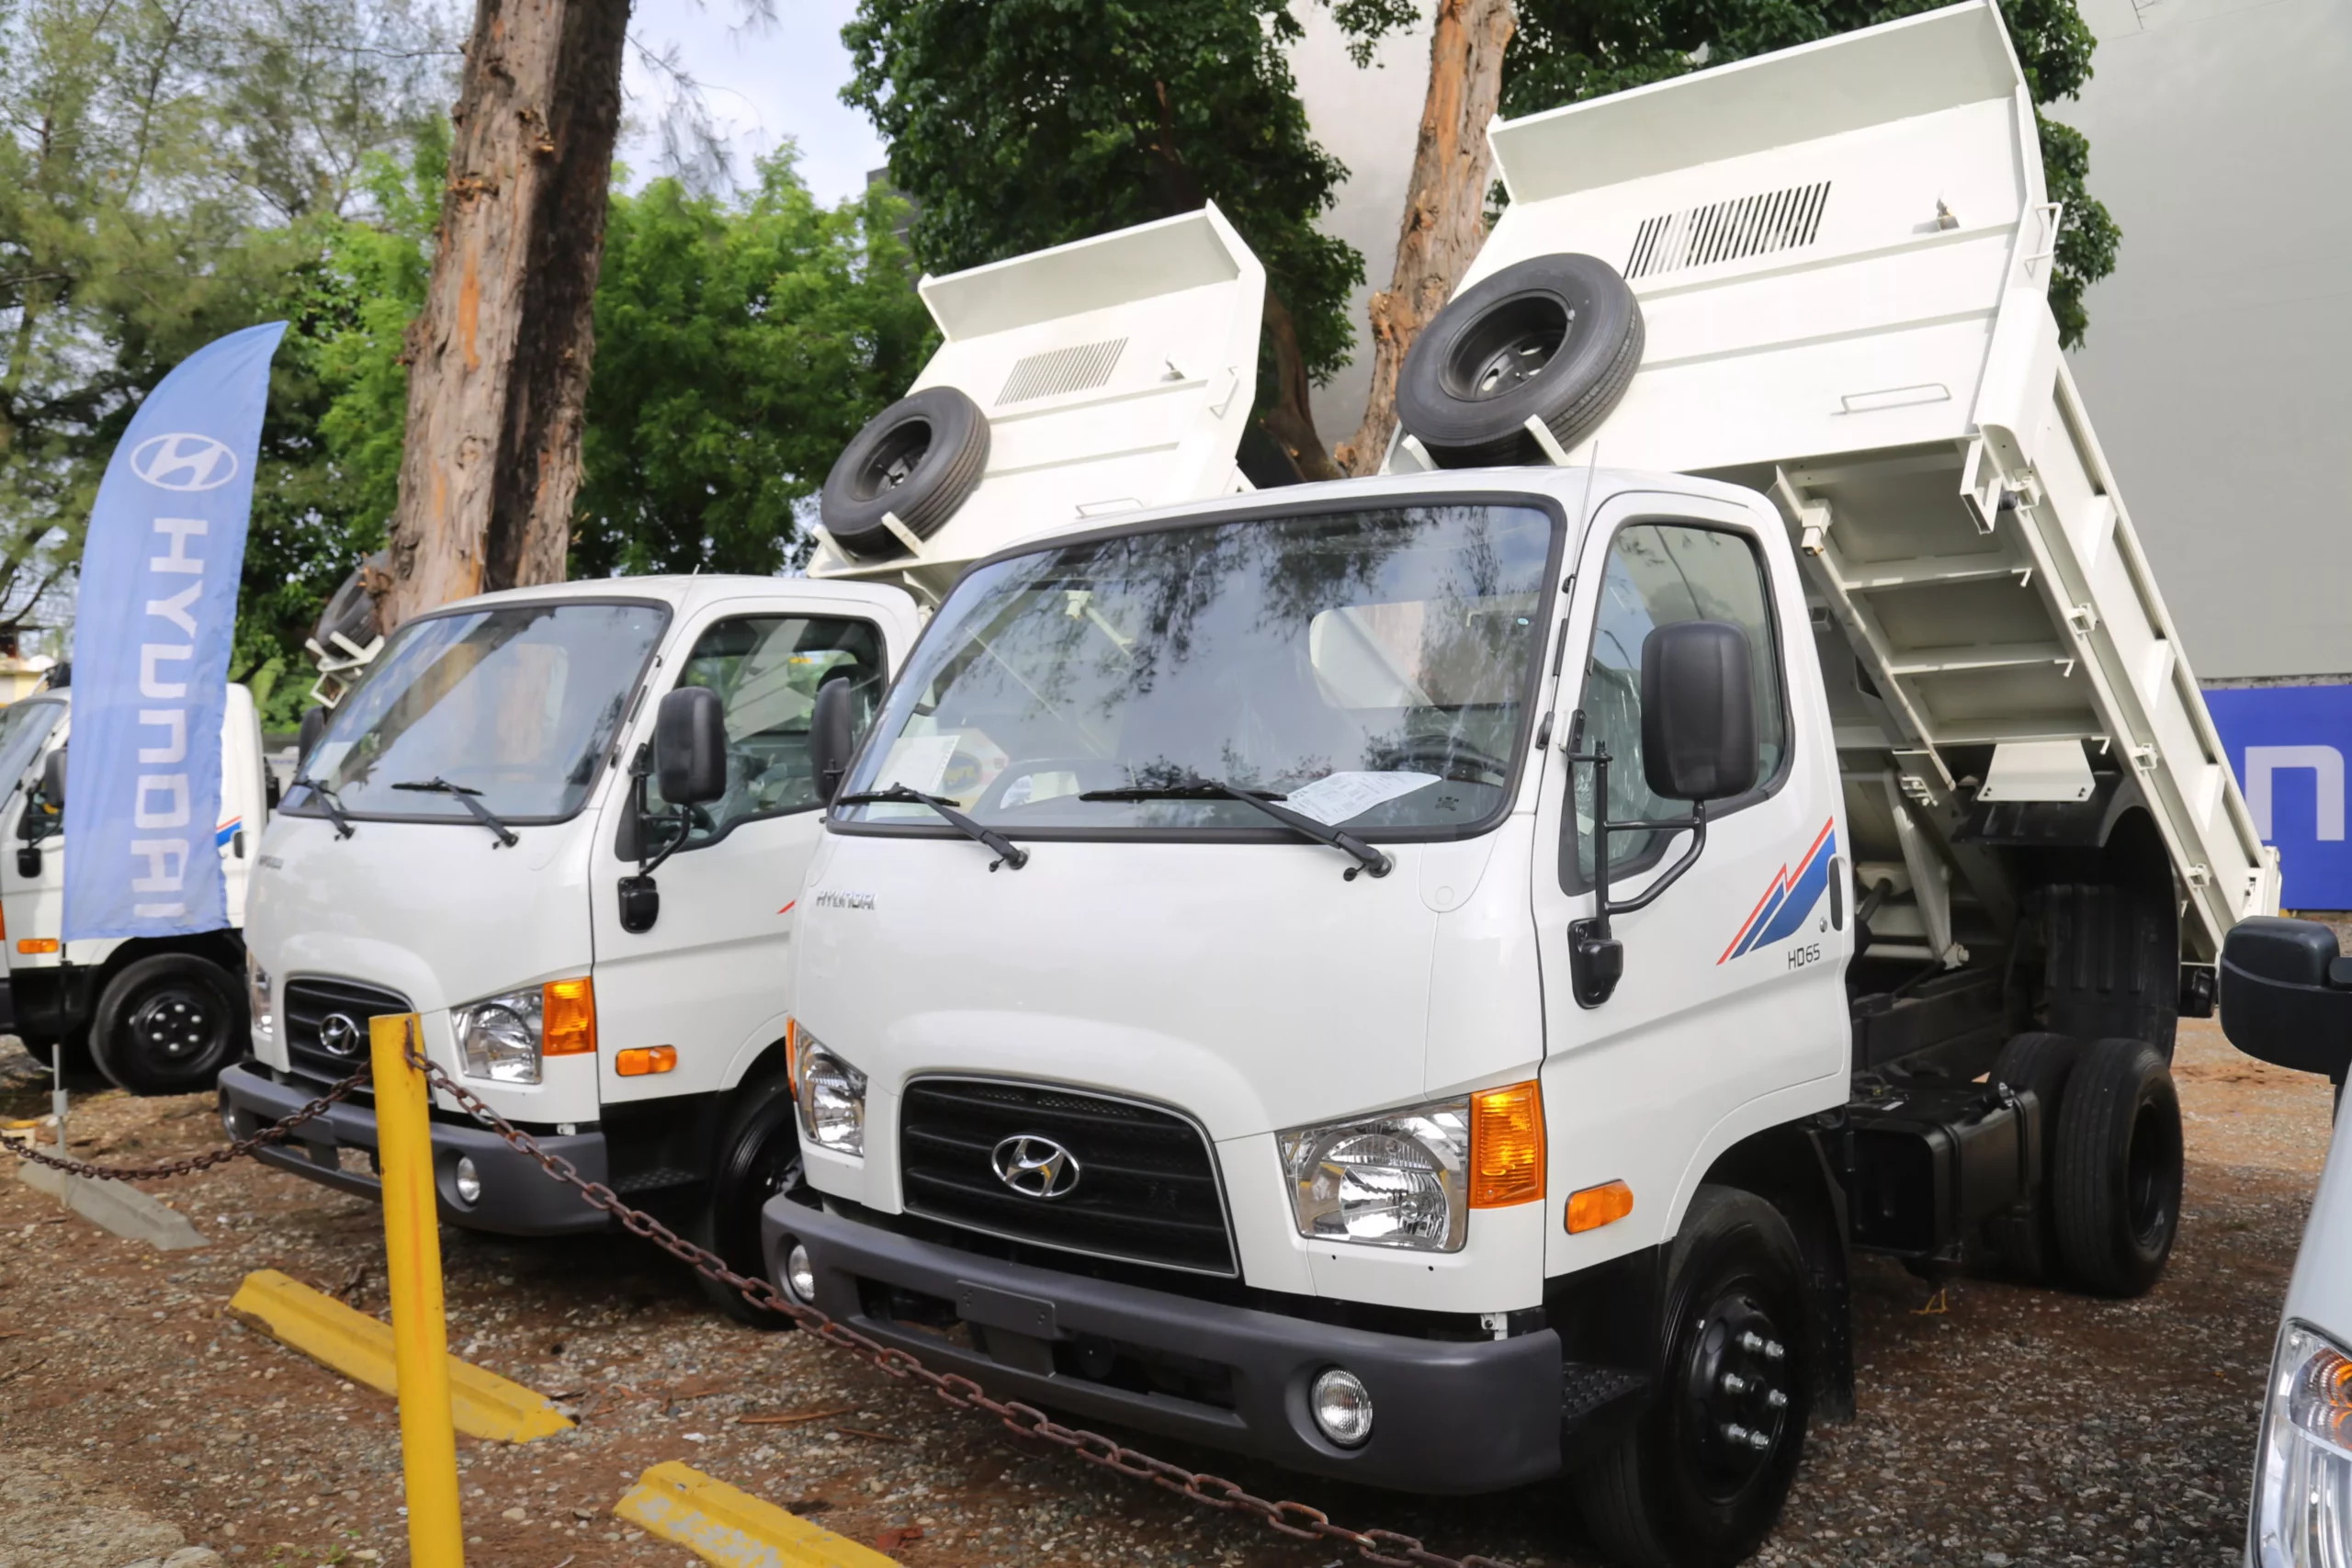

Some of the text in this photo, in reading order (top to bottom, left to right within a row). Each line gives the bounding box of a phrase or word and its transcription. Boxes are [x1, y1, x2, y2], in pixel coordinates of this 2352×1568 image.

[130, 517, 209, 919] HYUNDAI
[816, 890, 876, 910] HYUNDAI
[1787, 942, 1821, 970] HD65
